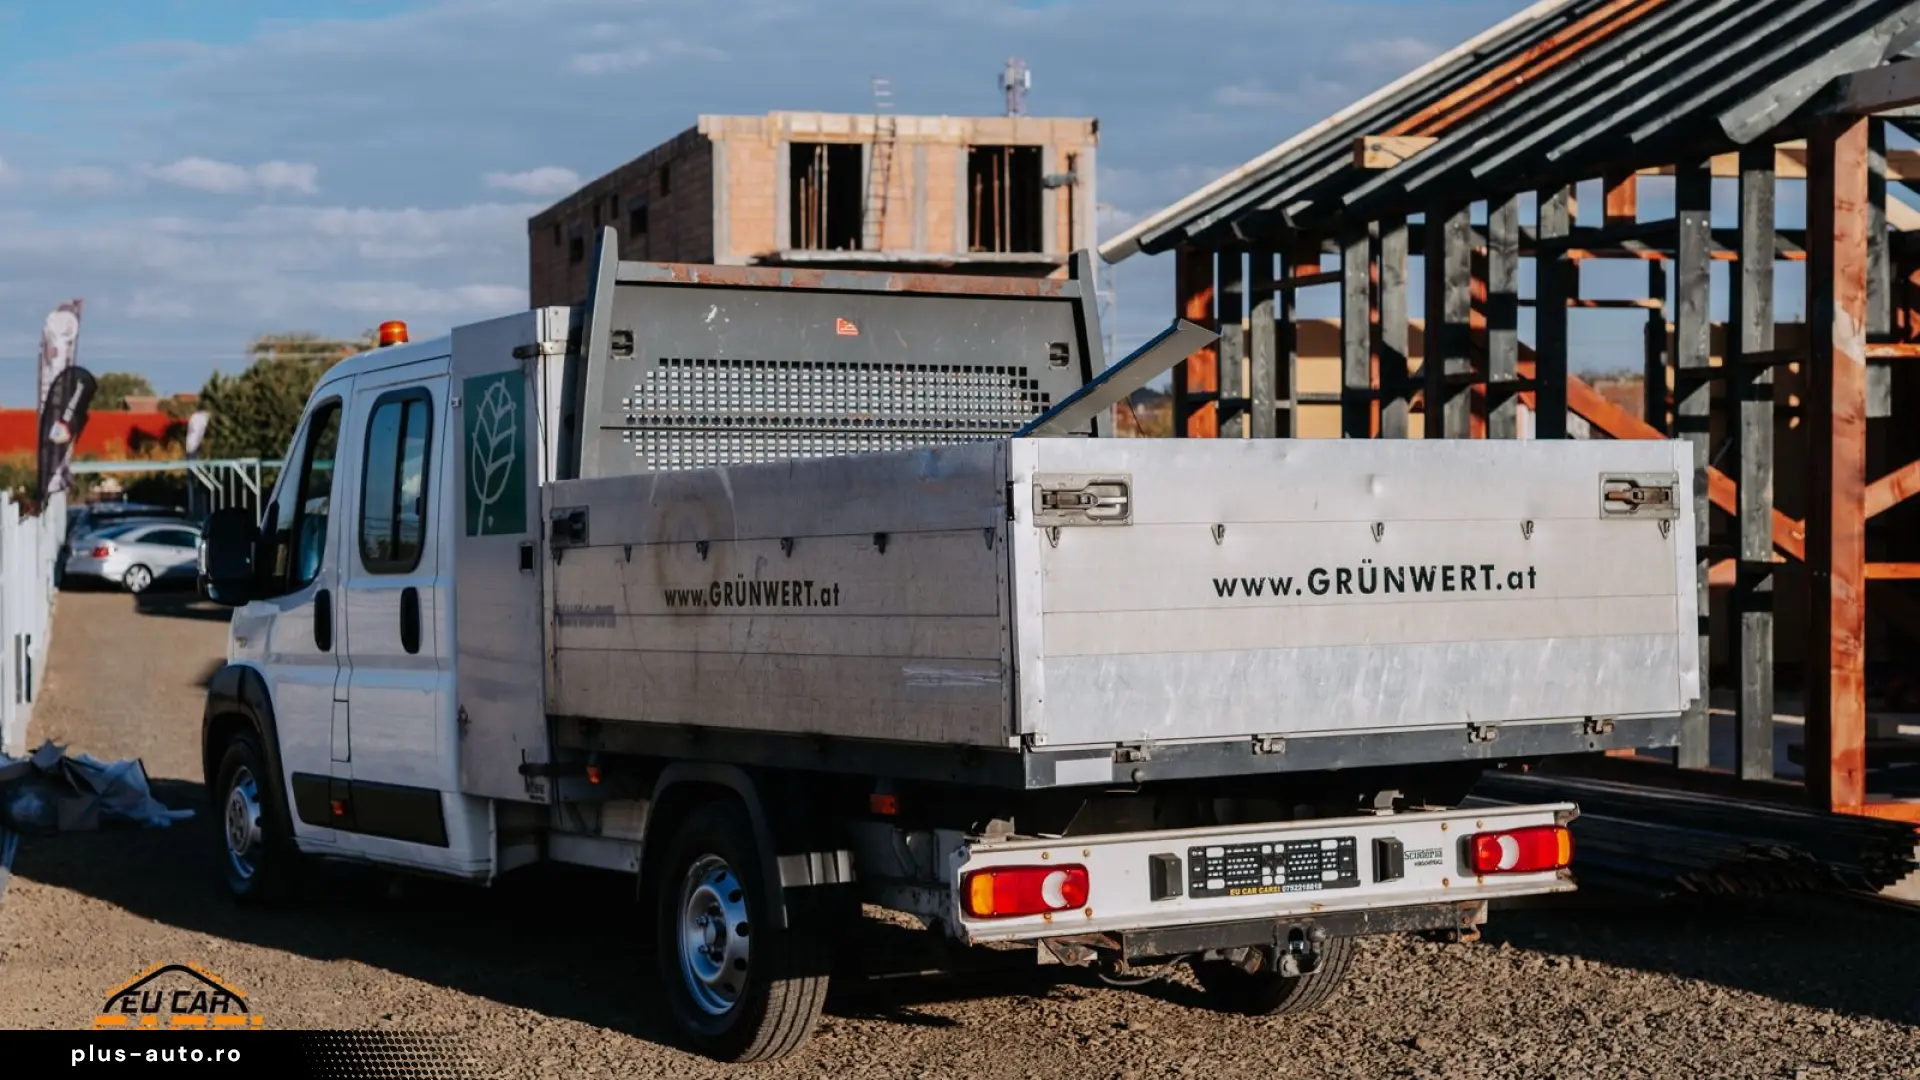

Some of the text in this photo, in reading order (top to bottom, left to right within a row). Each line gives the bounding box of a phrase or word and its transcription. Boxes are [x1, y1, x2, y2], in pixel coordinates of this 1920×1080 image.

[664, 573, 840, 607] www.GRÜNWERT.at
[1212, 558, 1537, 598] www.GRÜNWERT.at
[1229, 887, 1240, 896] EU
[1241, 886, 1257, 895] CAR
